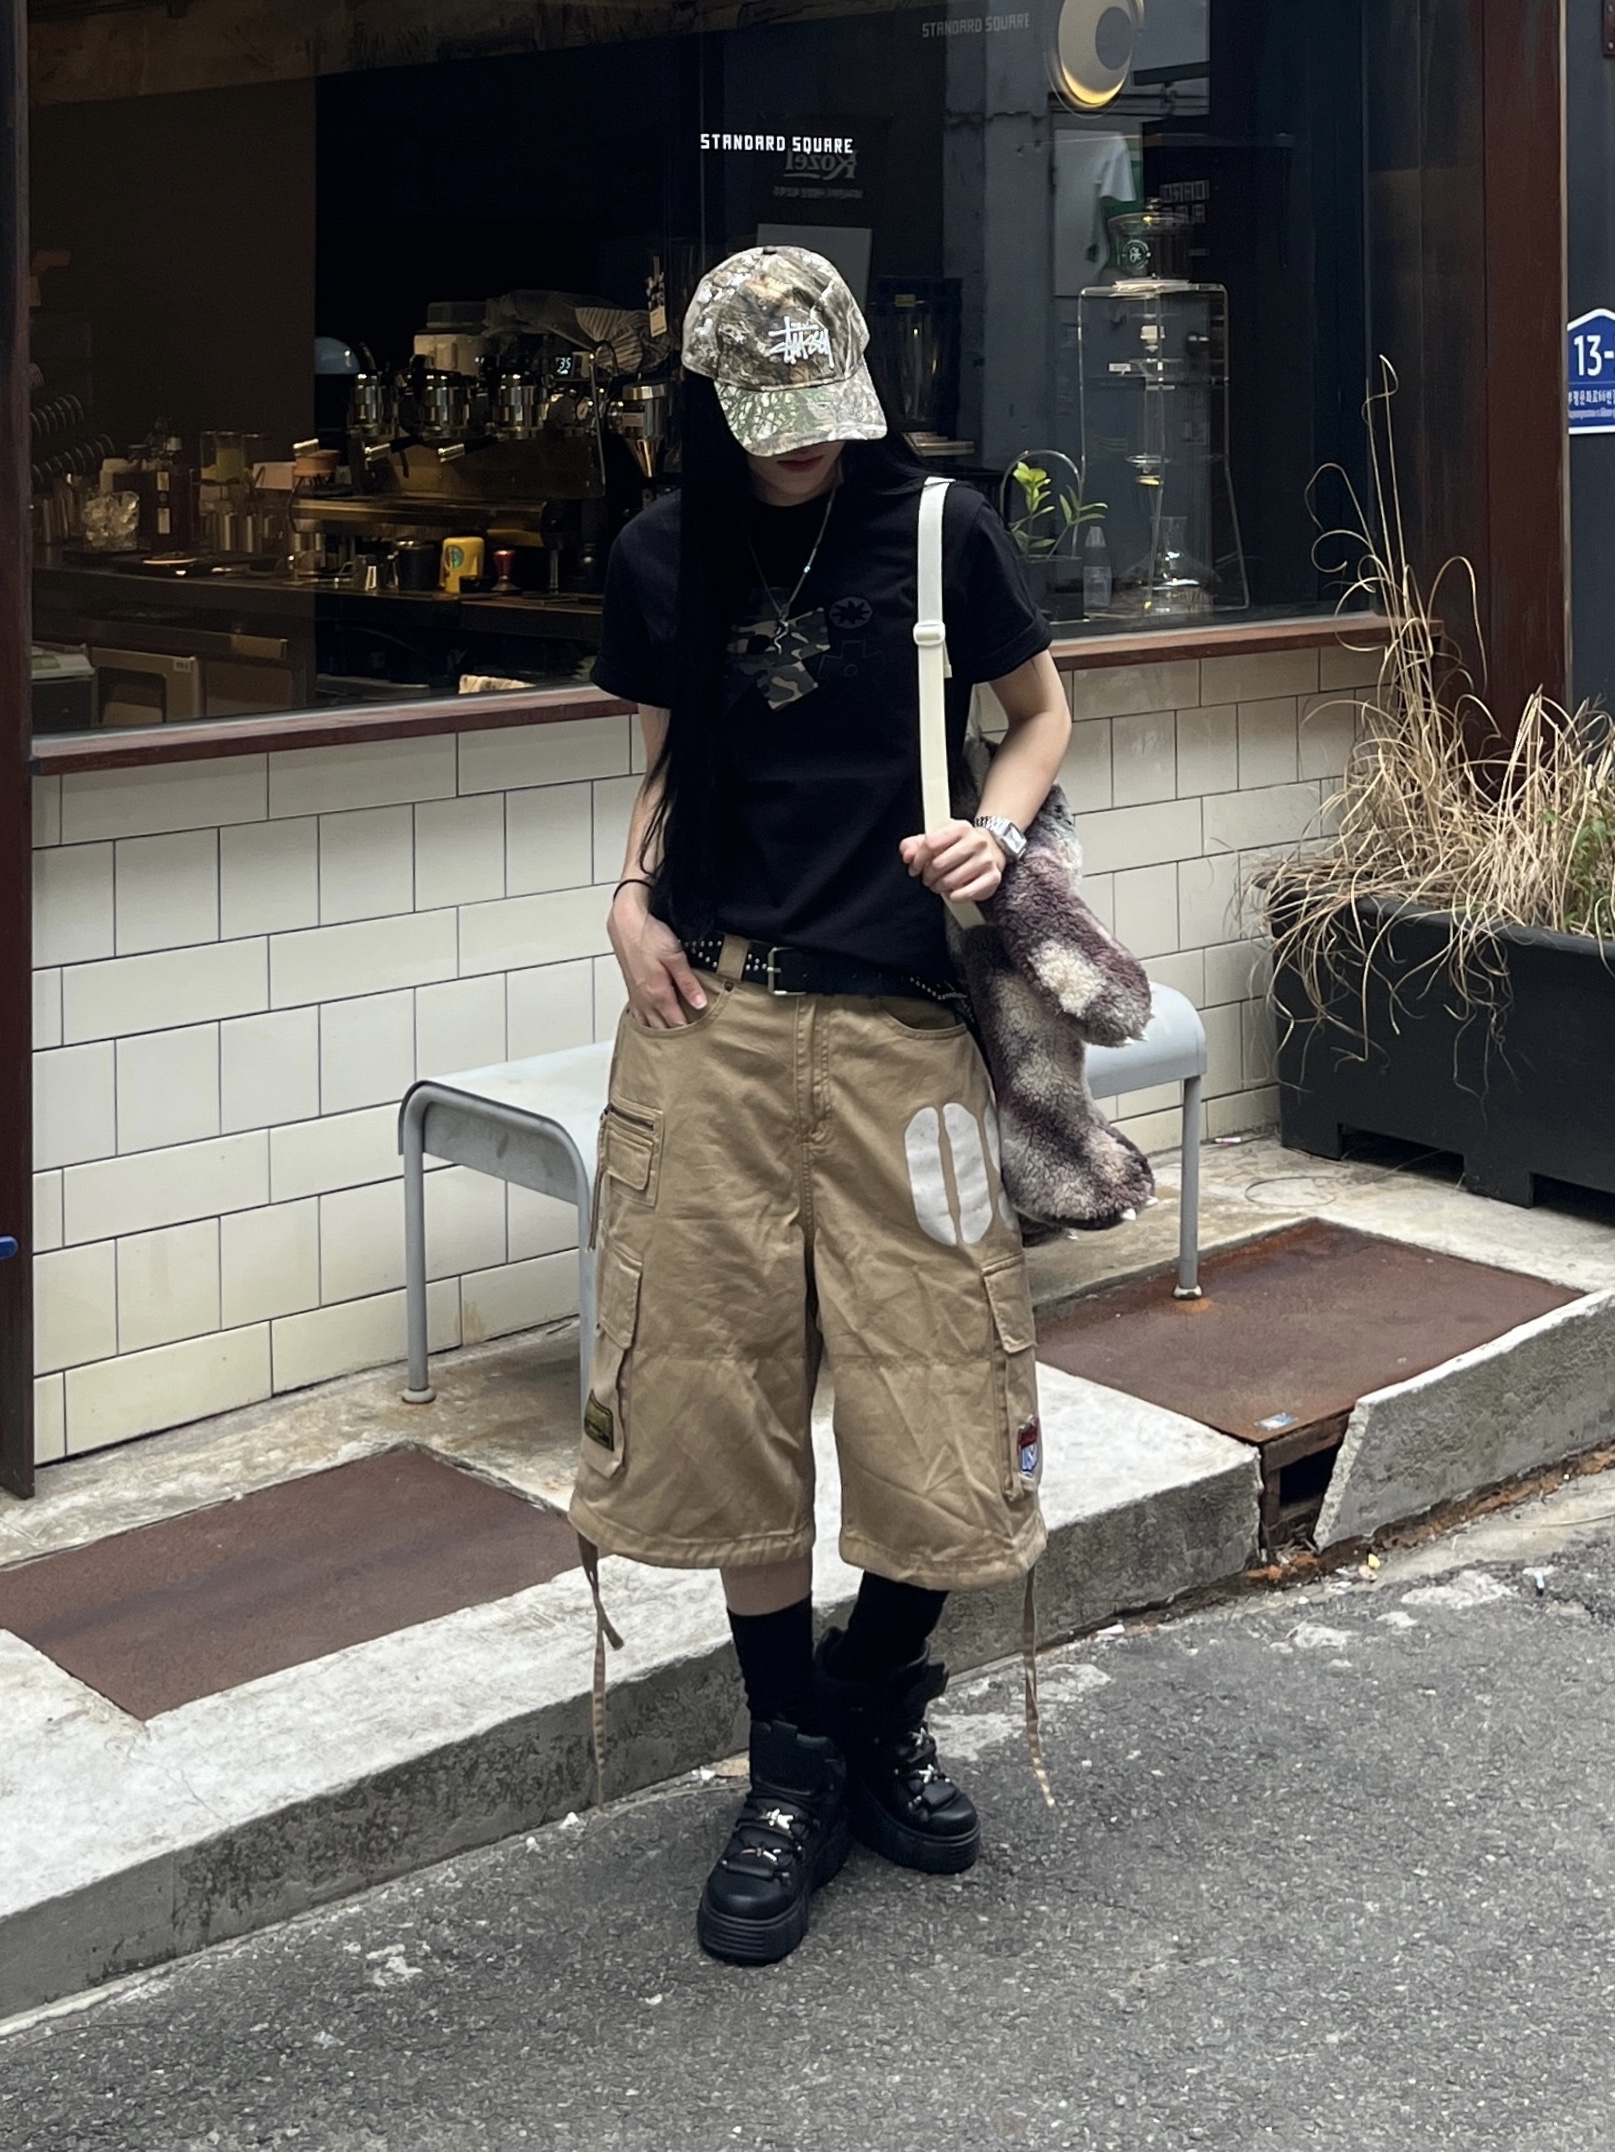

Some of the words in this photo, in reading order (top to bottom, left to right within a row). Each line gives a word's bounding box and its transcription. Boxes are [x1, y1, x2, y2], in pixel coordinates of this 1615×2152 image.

[922, 18, 982, 37] STANDARD
[985, 13, 1030, 32] SQUARE
[700, 133, 786, 151] STANDARD
[792, 136, 853, 154] SQUARE
[1573, 334, 1615, 376] 13-
